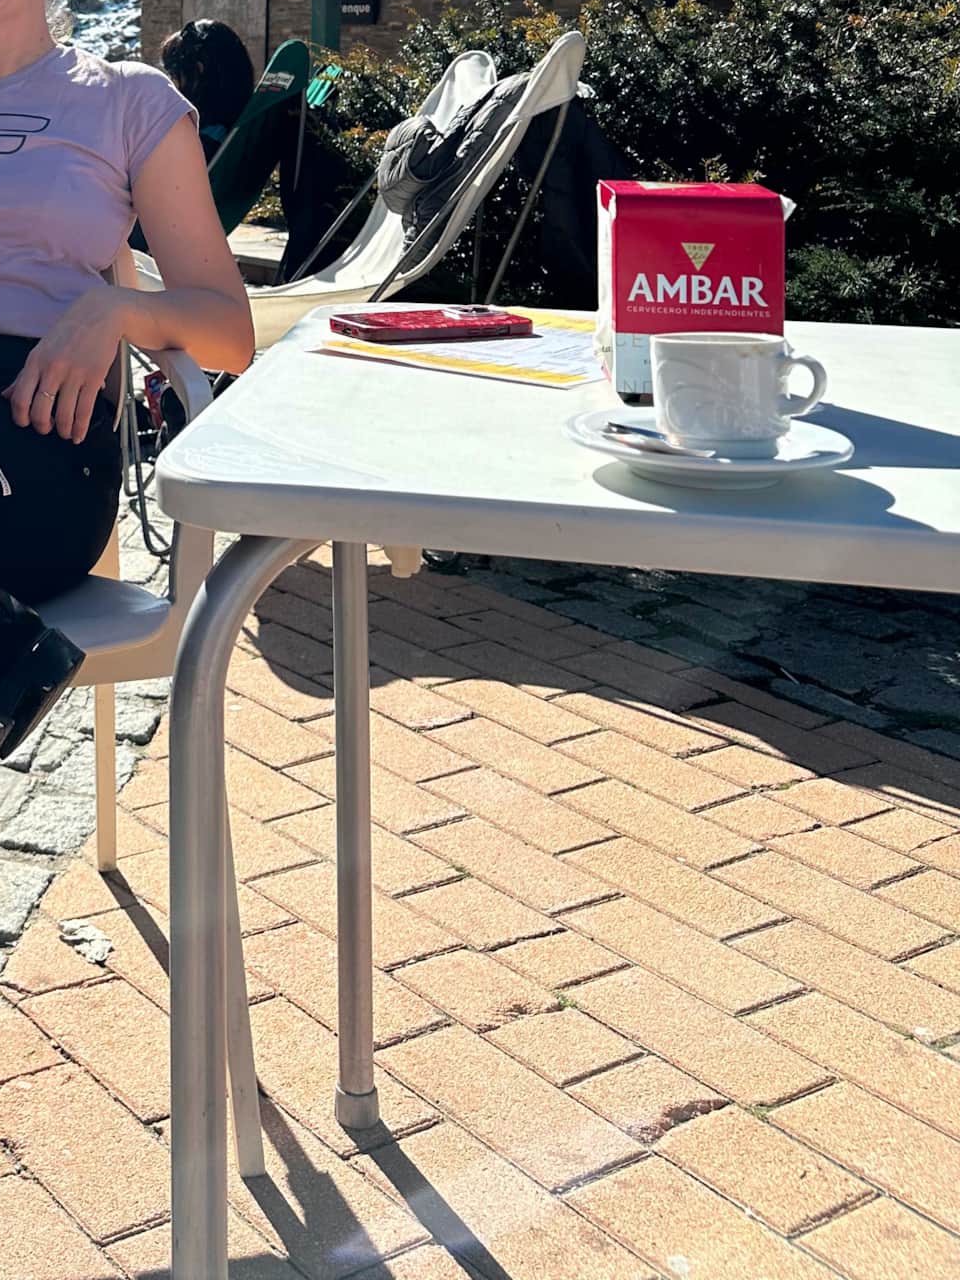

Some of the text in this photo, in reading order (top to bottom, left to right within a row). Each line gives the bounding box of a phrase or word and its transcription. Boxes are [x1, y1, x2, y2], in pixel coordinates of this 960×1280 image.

[342, 4, 370, 16] enque
[627, 272, 769, 307] AMBAR
[626, 305, 771, 318] CERVECEROS INDEPENDIENTES
